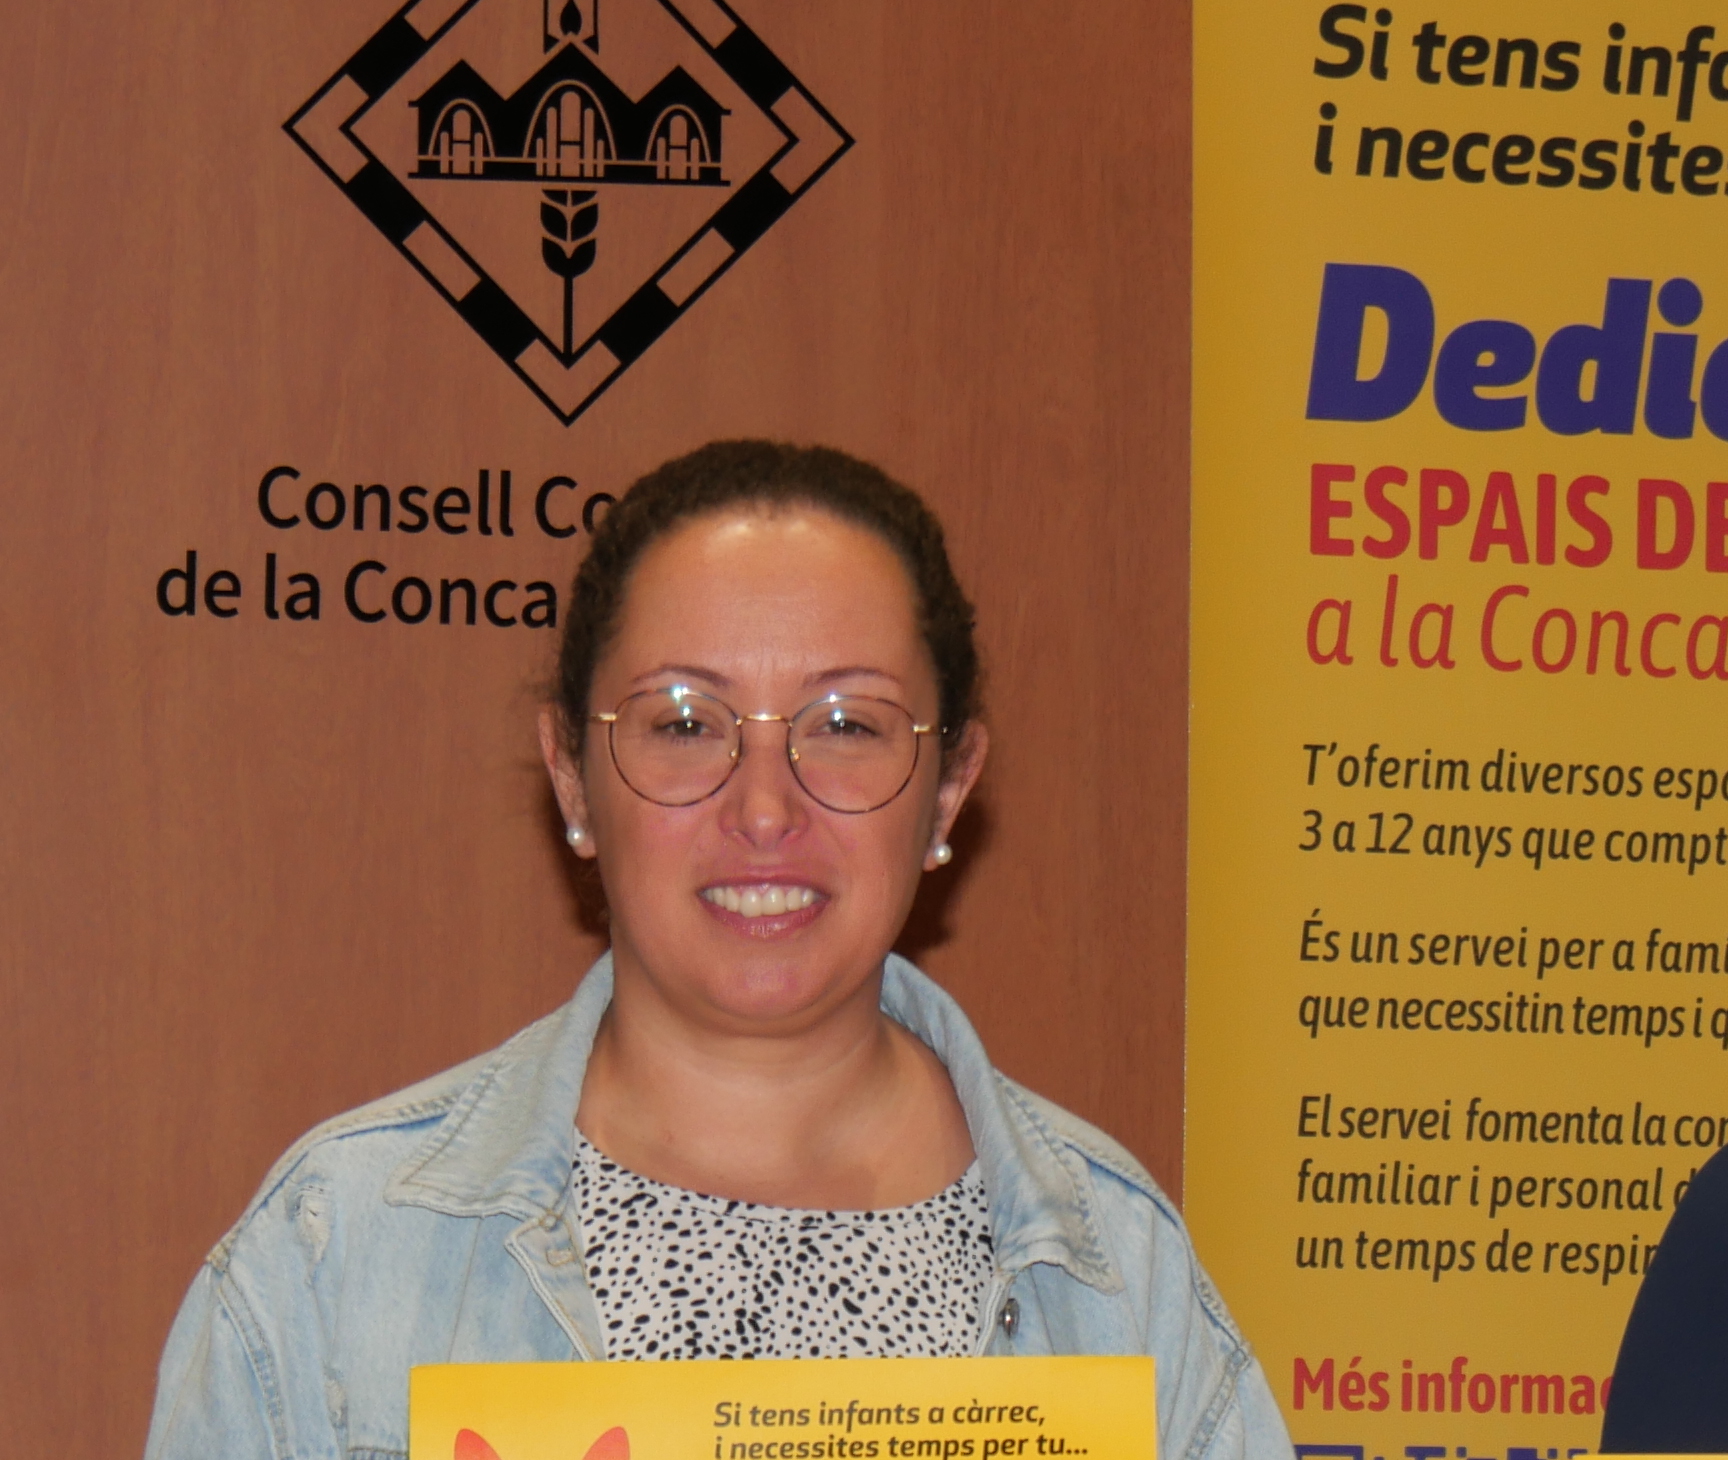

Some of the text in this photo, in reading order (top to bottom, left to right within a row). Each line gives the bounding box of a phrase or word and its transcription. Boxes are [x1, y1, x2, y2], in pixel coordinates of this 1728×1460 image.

[1314, 4, 1392, 80] Si
[1412, 22, 1581, 91] tens
[1315, 102, 1337, 174] i
[258, 466, 514, 536] Consell
[1310, 463, 1613, 568] ESPAIS
[157, 550, 557, 628] de la Conca
[1307, 599, 1353, 665] a
[1380, 574, 1455, 669] la
[1303, 742, 1470, 791] T'oferim
[1481, 748, 1643, 797] diversos
[1298, 1094, 1331, 1137] El
[1338, 1100, 1451, 1140] servei
[1466, 1097, 1623, 1145] fomenta
[1632, 1102, 1666, 1146] la
[714, 1399, 1045, 1432] Si tens infants a càrrec,
[1292, 1356, 1616, 1415] Més informa
[715, 1436, 722, 1459] i
[730, 1434, 879, 1459] necessites
[1036, 1434, 1087, 1455] tu...
